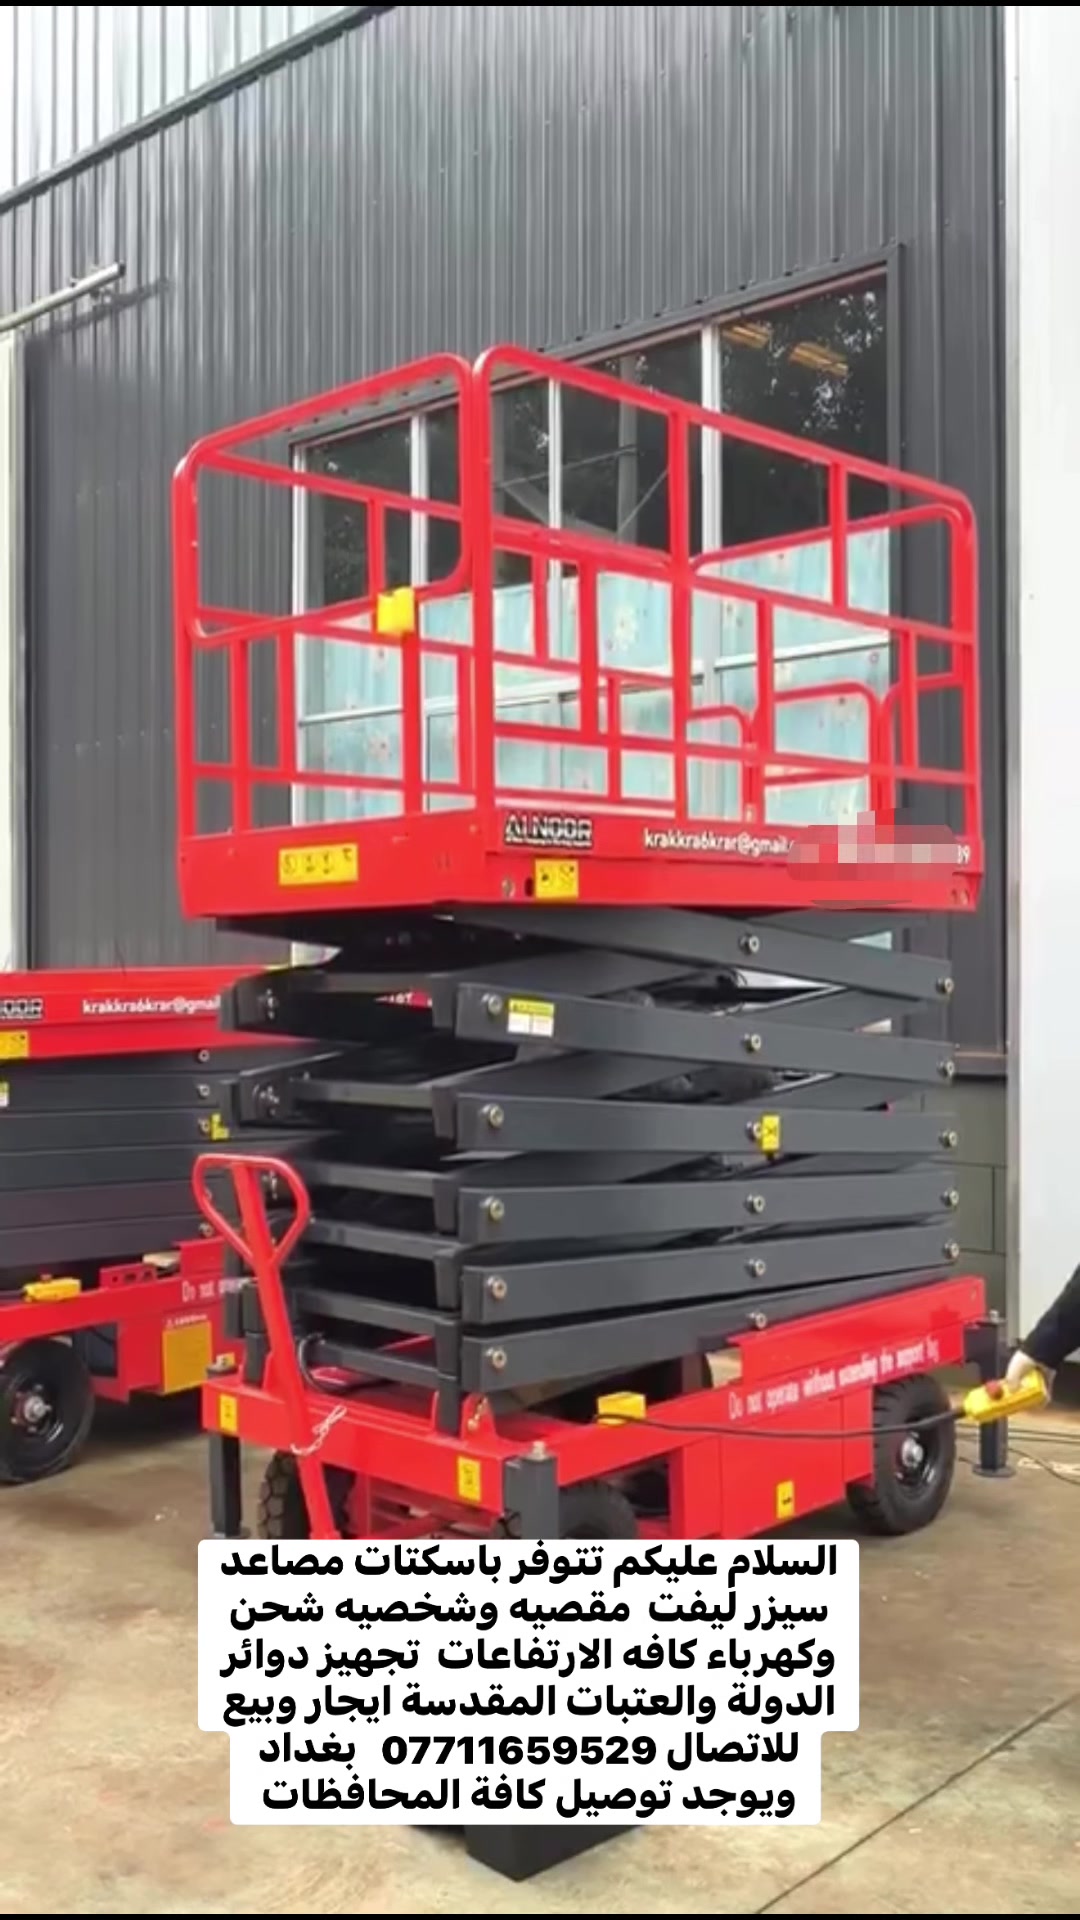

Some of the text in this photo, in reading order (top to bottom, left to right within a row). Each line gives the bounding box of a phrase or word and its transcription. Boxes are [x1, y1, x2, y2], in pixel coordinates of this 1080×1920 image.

[728, 1391, 743, 1420] Do
[747, 1392, 762, 1415] not
[766, 1382, 799, 1413] operate
